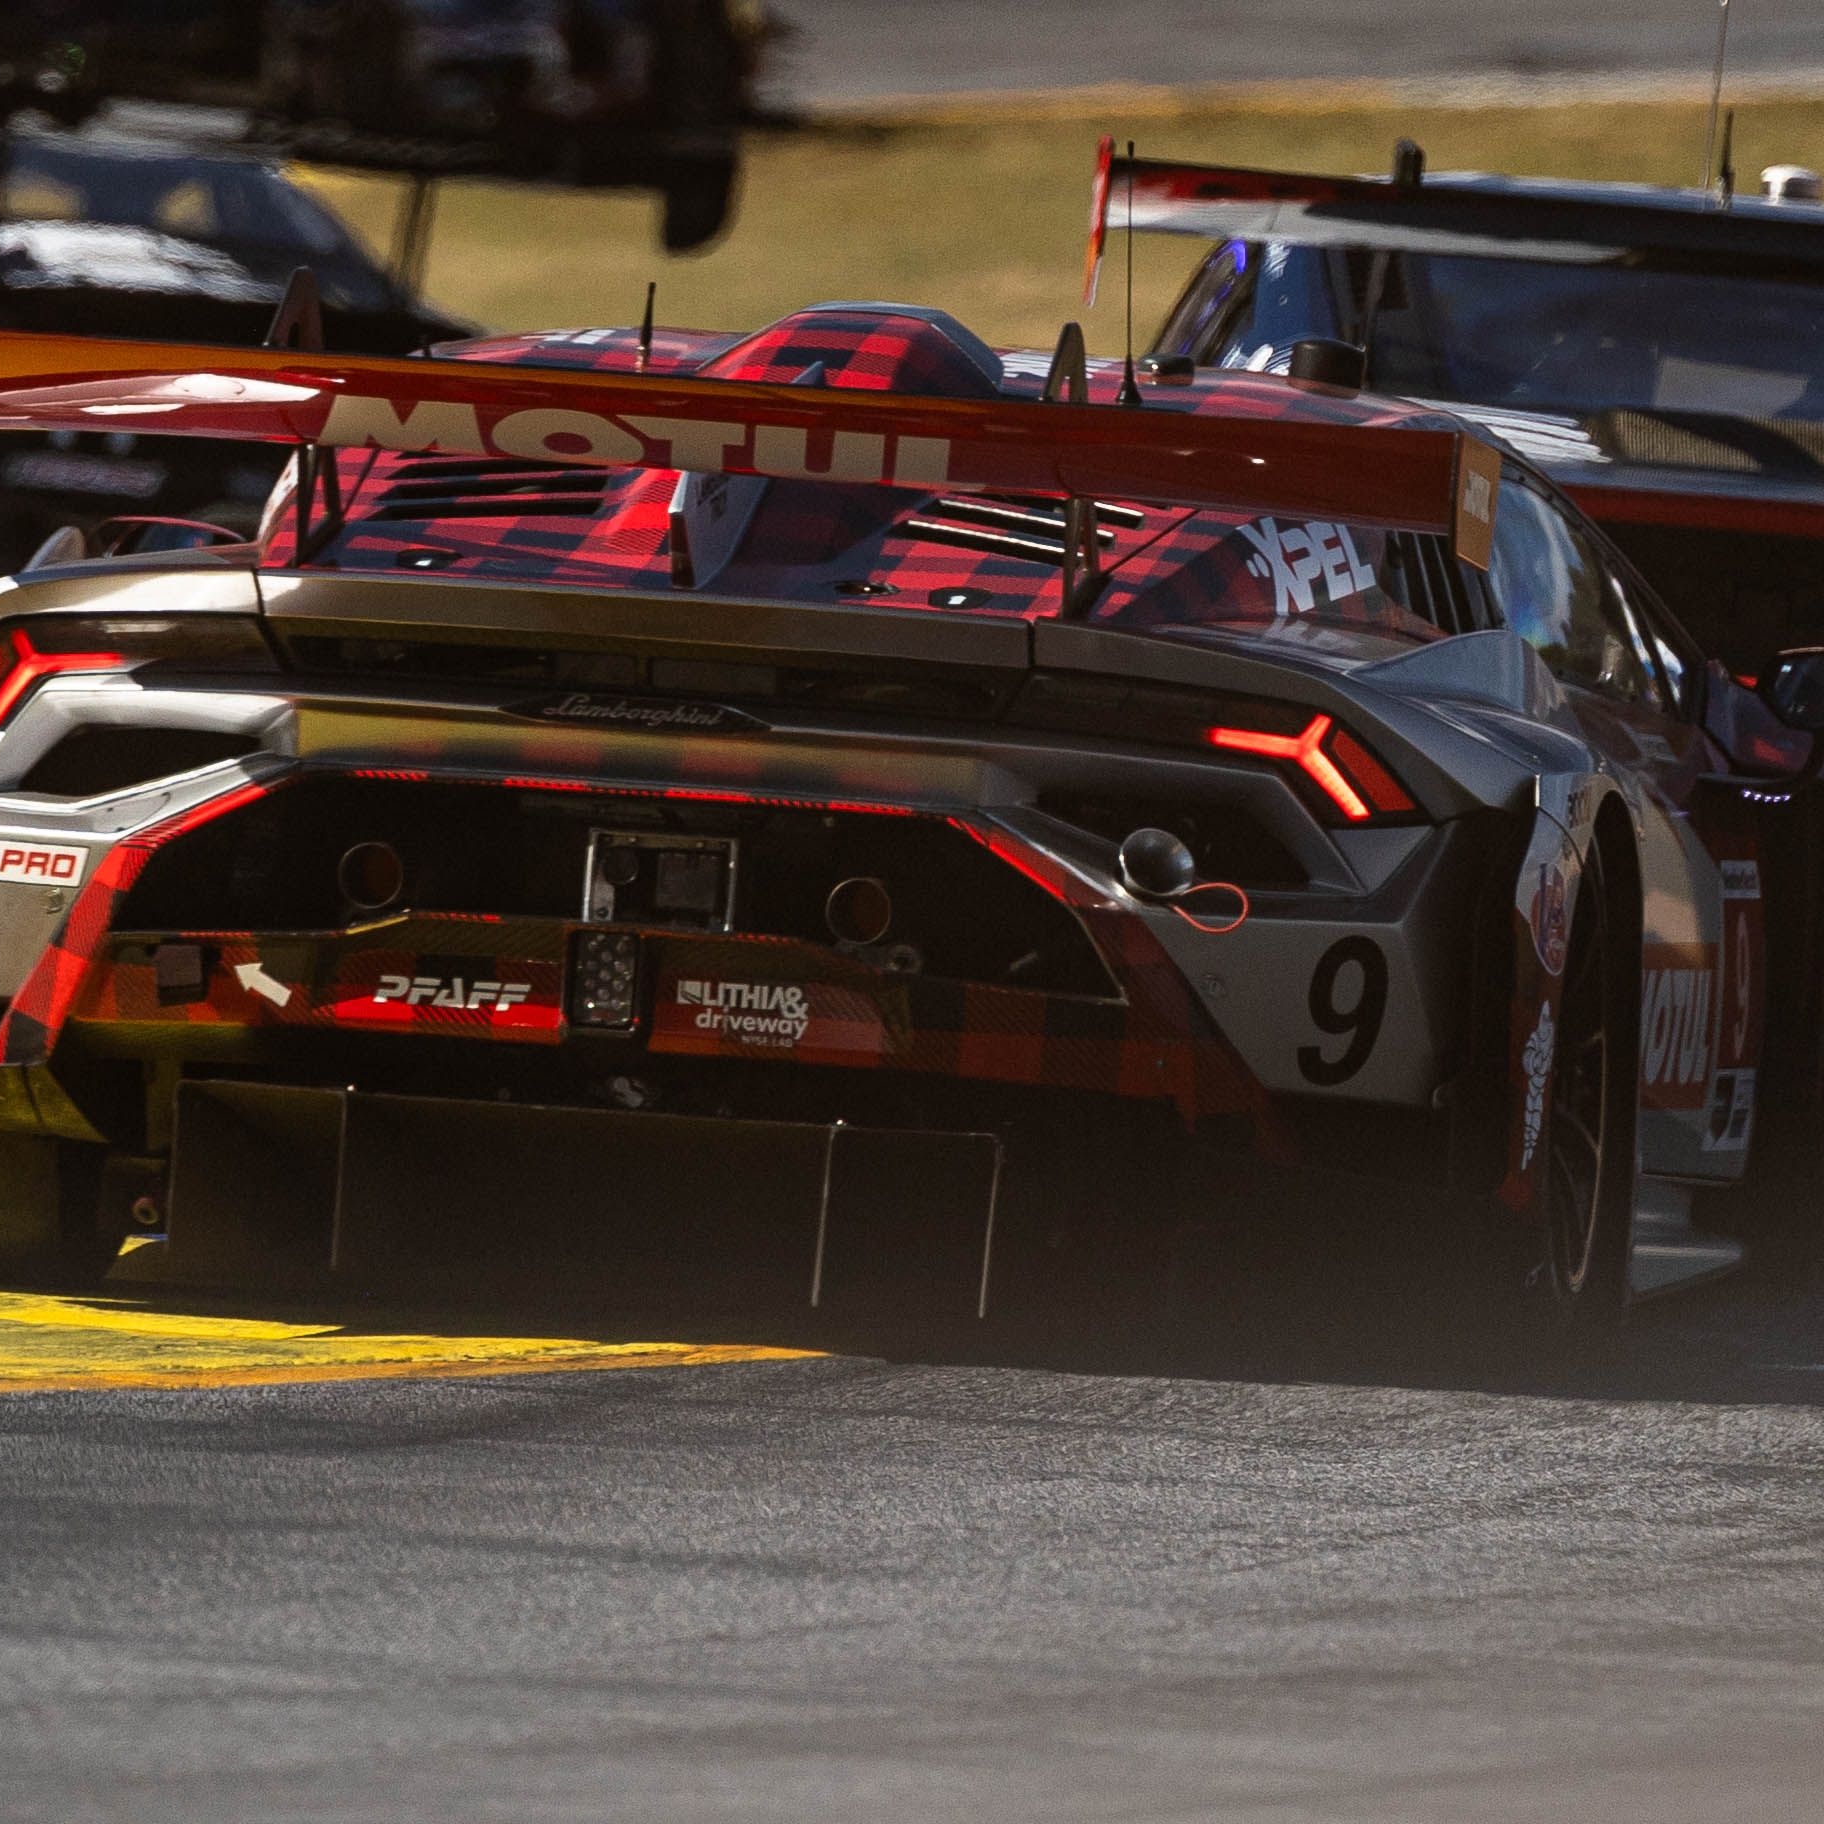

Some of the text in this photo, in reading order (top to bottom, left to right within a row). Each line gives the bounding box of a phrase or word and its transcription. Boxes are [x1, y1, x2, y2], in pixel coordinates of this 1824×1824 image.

[318, 393, 953, 486] MOTUL
[1235, 516, 1377, 616] XPEL
[543, 693, 724, 727] Lamborghini
[0, 848, 77, 879] PRO
[373, 974, 532, 1012] PFAFF
[1297, 934, 1389, 1087] 9
[695, 1007, 809, 1040] driveway
